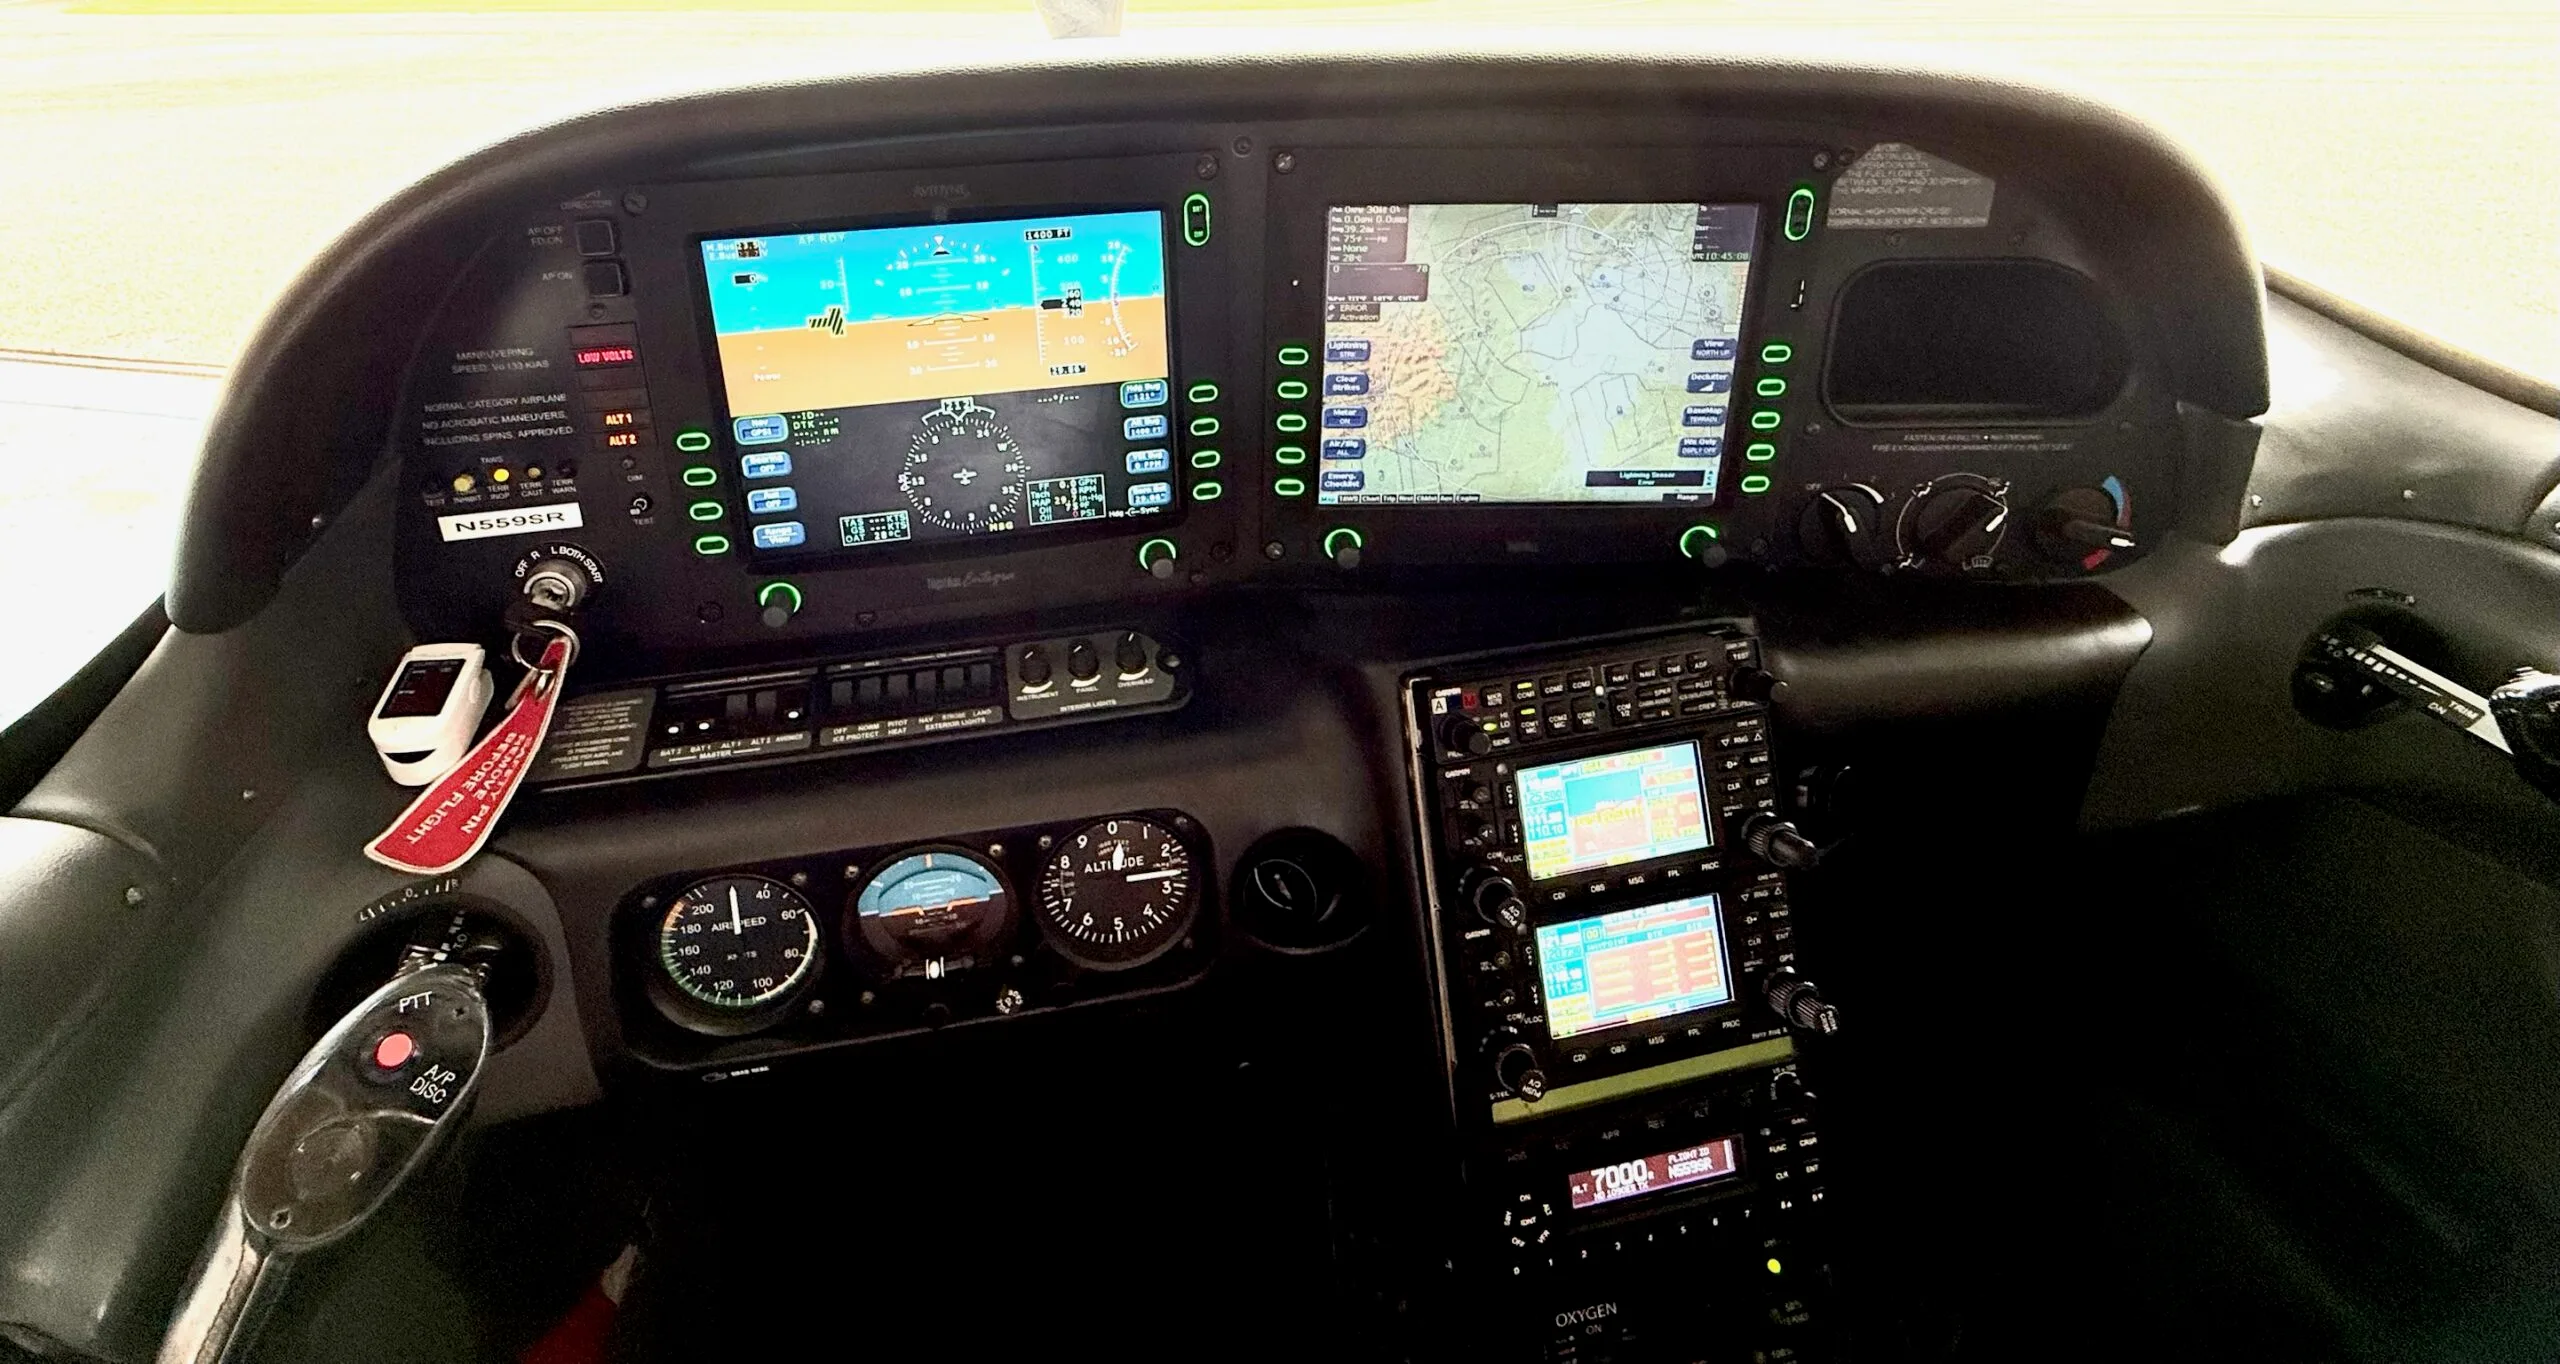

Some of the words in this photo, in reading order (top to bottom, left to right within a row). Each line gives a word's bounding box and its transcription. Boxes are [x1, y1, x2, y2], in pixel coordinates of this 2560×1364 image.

[1056, 229, 1070, 239] FT
[799, 236, 814, 245] AP
[1343, 245, 1368, 253] None
[1340, 304, 1368, 312] ERROR
[1340, 313, 1379, 321] Activation
[1329, 342, 1367, 350] Lightning
[578, 352, 600, 363] LOW
[603, 350, 633, 361] VOLTS
[1333, 384, 1360, 392] Strikes
[425, 402, 465, 412] NORMAL
[470, 398, 518, 409] CATEGORY
[520, 394, 567, 405] AIRPLANE
[944, 401, 970, 411] 212
[439, 416, 498, 429] ACROBATIC
[606, 415, 625, 425] ALT
[626, 414, 632, 423] 1
[793, 421, 815, 429] DTK
[424, 433, 480, 446] INCLUDING
[610, 436, 627, 446] ALT
[628, 435, 637, 445] 2
[1619, 472, 1650, 480] Lightning
[1039, 483, 1049, 491] FF
[1059, 480, 1077, 489] 0.0
[1078, 478, 1097, 486] GPH
[1324, 480, 1359, 488] Checklist
[1806, 482, 1822, 491] OFF
[1031, 491, 1050, 499] Tach
[1032, 499, 1051, 507] MAP
[1039, 507, 1052, 515] Oil
[1081, 509, 1095, 517] PSI
[1140, 506, 1159, 514] Sync
[456, 511, 565, 532] N559SR
[844, 518, 864, 527] TAS
[845, 534, 866, 543] OAT
[551, 546, 557, 554] L
[559, 546, 586, 561] BOTH
[530, 551, 540, 560] R
[515, 559, 528, 577] OFF
[583, 558, 603, 583] START
[1733, 652, 1749, 660] TEST
[1695, 661, 1707, 669] ADF
[1117, 678, 1154, 688] OVERHEAD
[1695, 681, 1712, 689] PILOT
[1076, 685, 1099, 694] PANEL
[1016, 691, 1059, 702] INSTRUMENT
[1060, 703, 1093, 712] INTERIOR
[1094, 699, 1117, 708] LIGHTS
[1435, 701, 1444, 711] A
[2448, 700, 2480, 720] TRIM
[972, 709, 992, 717] LAND
[887, 719, 908, 728] PITOT
[918, 716, 934, 724] NAV
[925, 721, 959, 731] EXTERIOR
[961, 717, 986, 728] LIGHTS
[833, 727, 848, 735] OFF
[858, 723, 880, 732] NORM
[888, 728, 907, 736] HEAT
[833, 735, 846, 743] ICE
[847, 730, 879, 741] PROTECT
[690, 745, 704, 753] BAT
[699, 750, 732, 759] MASTER
[461, 732, 518, 791] BEFORE
[1445, 768, 1470, 778] GARMIN
[1727, 783, 1740, 791] CLR
[1758, 799, 1773, 807] GPS
[406, 791, 465, 845] FLIGHT
[460, 804, 490, 834] PIN
[1108, 821, 1118, 834] 0
[1144, 826, 1148, 839] 1
[1077, 835, 1087, 848] 9
[1161, 844, 1170, 857] 2
[1061, 856, 1070, 869] 8
[1085, 856, 1144, 873] ALTIUDE
[1702, 861, 1719, 871] PROC
[1668, 869, 1680, 878] FPL
[1628, 875, 1644, 885] MSG
[1162, 881, 1171, 894] 3
[1591, 884, 1606, 893] OBS
[756, 889, 770, 900] 40
[1553, 892, 1566, 901] CDI
[692, 903, 714, 915] 200
[1063, 898, 1072, 912] 7
[1143, 904, 1153, 916] 4
[781, 910, 796, 920] 60
[1083, 912, 1093, 926] 6
[1114, 917, 1123, 930] 5
[680, 924, 701, 934] 180
[1465, 929, 1491, 940] GARMIN
[1748, 938, 1761, 946] CLR
[678, 945, 700, 956] 160
[784, 948, 799, 958] 80
[1779, 953, 1794, 962] GPS
[690, 965, 711, 976] 140
[713, 979, 734, 991] 120
[753, 977, 773, 988] 100
[400, 991, 432, 1013] PTT
[1722, 1020, 1740, 1029] PROC
[1688, 1027, 1701, 1037] FPL
[1648, 1034, 1665, 1046] MSG
[1611, 1044, 1626, 1055] OBS
[1572, 1053, 1587, 1063] CDI
[423, 1064, 456, 1085] A/P
[409, 1077, 446, 1104] DISC
[1522, 1085, 1541, 1098] PUSH
[1769, 1144, 1787, 1153] FUNC
[1668, 1149, 1697, 1164] FLIGHT
[1699, 1147, 1710, 1156] ID
[1806, 1164, 1819, 1173] ENT
[1590, 1159, 1647, 1192] 7000
[1572, 1183, 1589, 1194] ALT
[1520, 1194, 1531, 1202] ON
[1512, 1237, 1525, 1247] OFF
[1556, 1302, 1617, 1327] OXYGEN
[1586, 1324, 1602, 1335] ON
